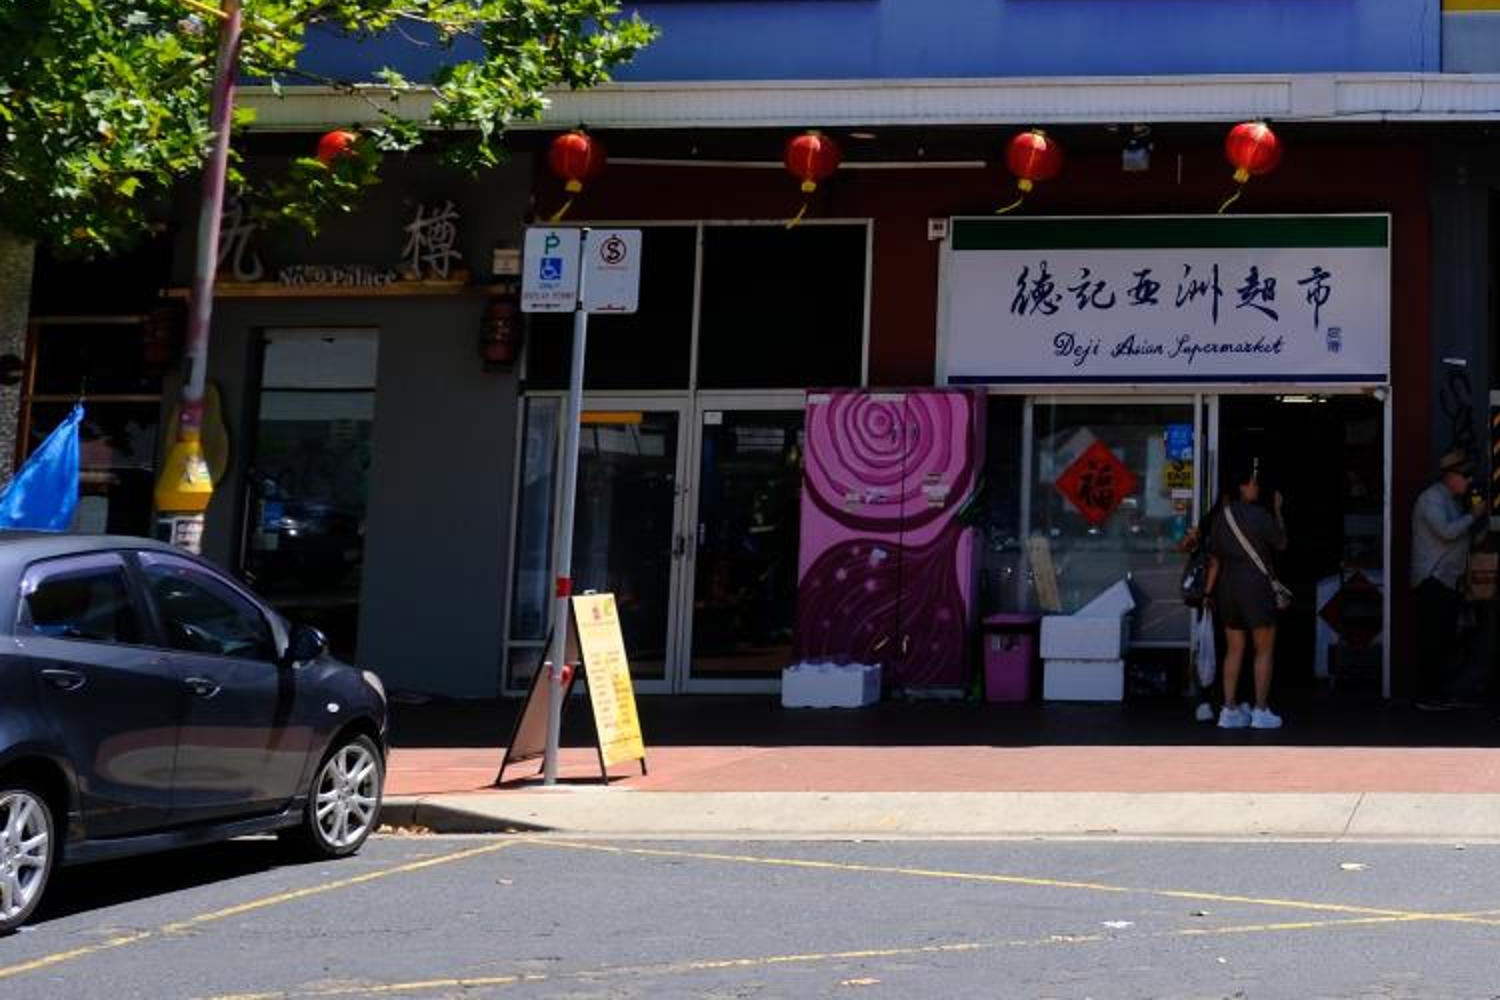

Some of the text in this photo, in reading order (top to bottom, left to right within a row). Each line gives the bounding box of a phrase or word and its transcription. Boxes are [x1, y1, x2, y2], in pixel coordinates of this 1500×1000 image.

[545, 232, 560, 254] P
[1053, 332, 1284, 368] Deji Asian Supermarket
